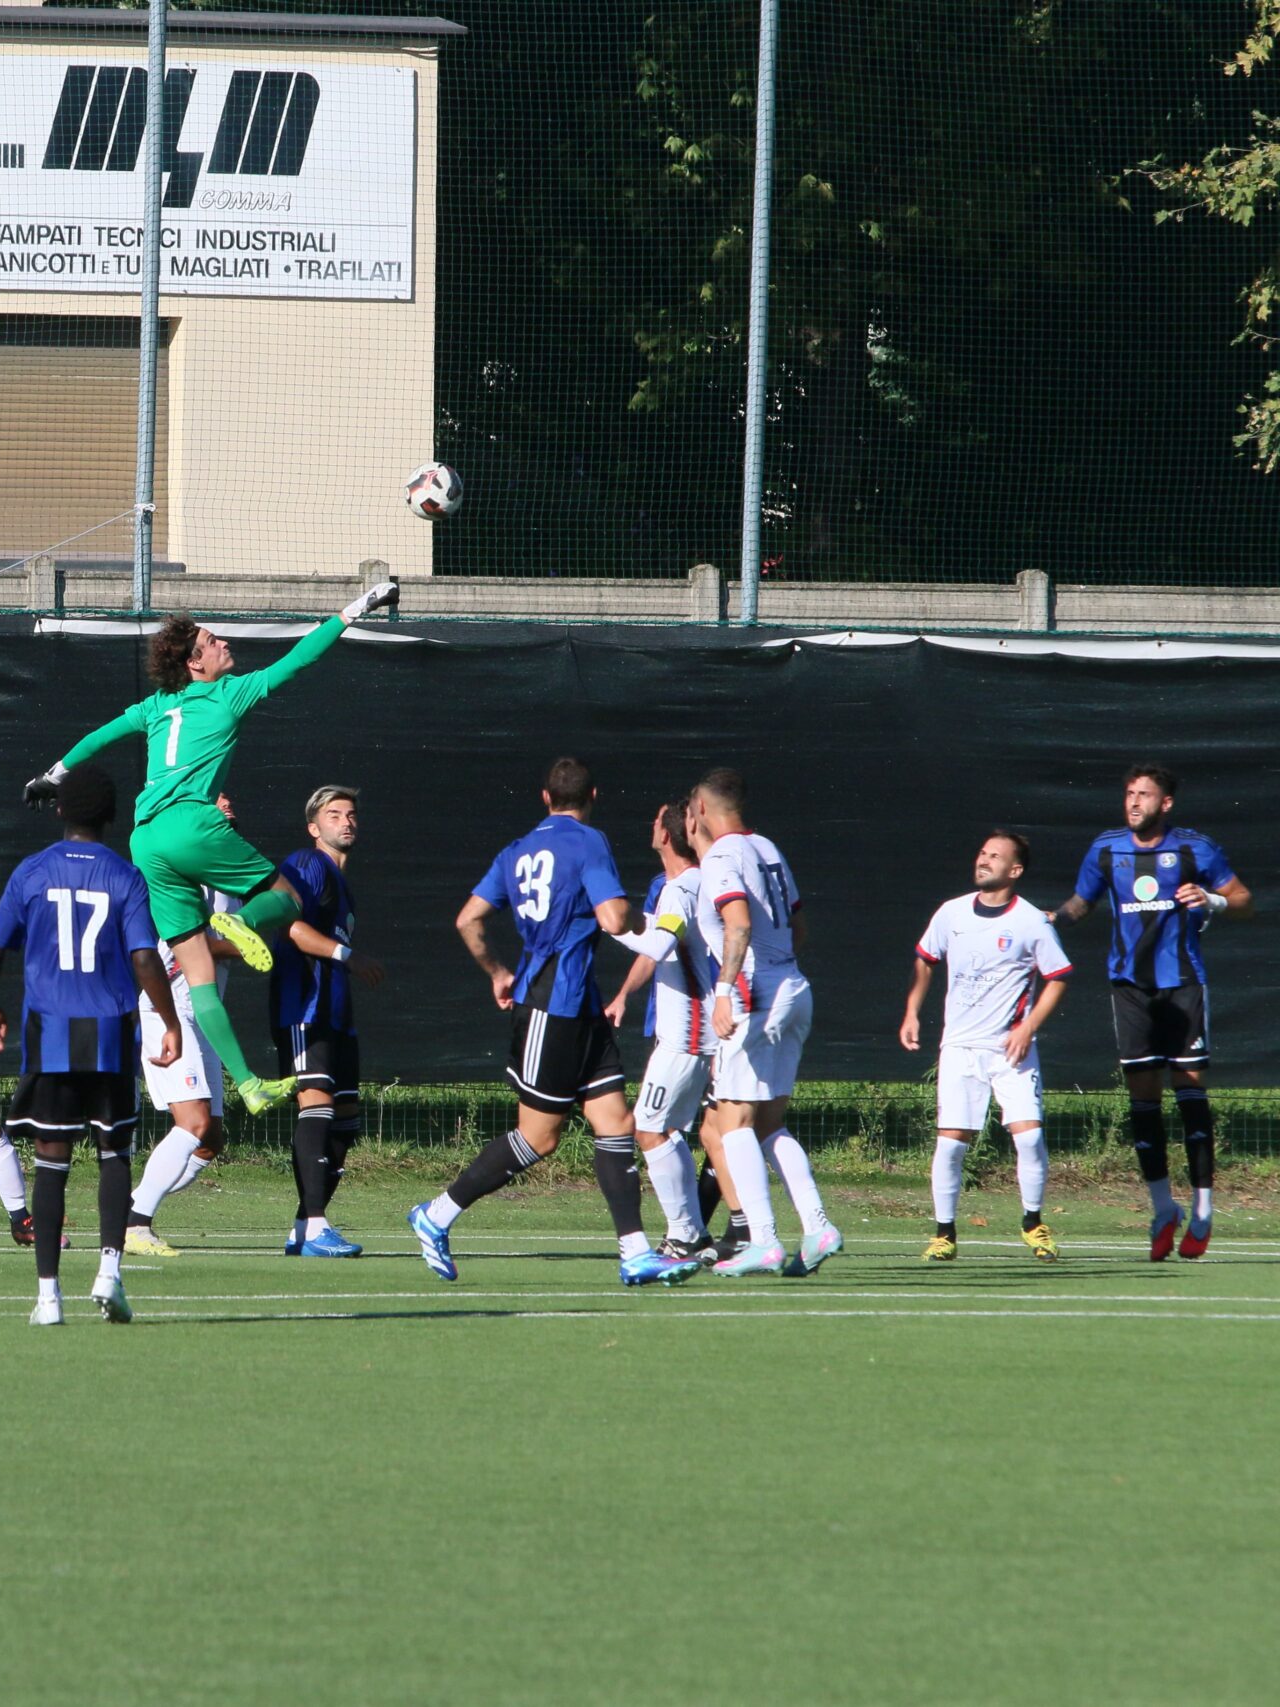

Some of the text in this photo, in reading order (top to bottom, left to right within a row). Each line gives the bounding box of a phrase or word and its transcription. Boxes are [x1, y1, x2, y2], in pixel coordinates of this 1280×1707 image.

[199, 189, 292, 212] GOMMA
[93, 226, 181, 248] TECNCI
[196, 229, 336, 253] INDUSTRIALI
[171, 256, 269, 278] MAGLIATI
[294, 259, 402, 281] TRAFILATI
[515, 849, 555, 922] 33
[1121, 900, 1175, 913] ECONORD
[47, 888, 109, 973] 17
[644, 1081, 667, 1110] 10
